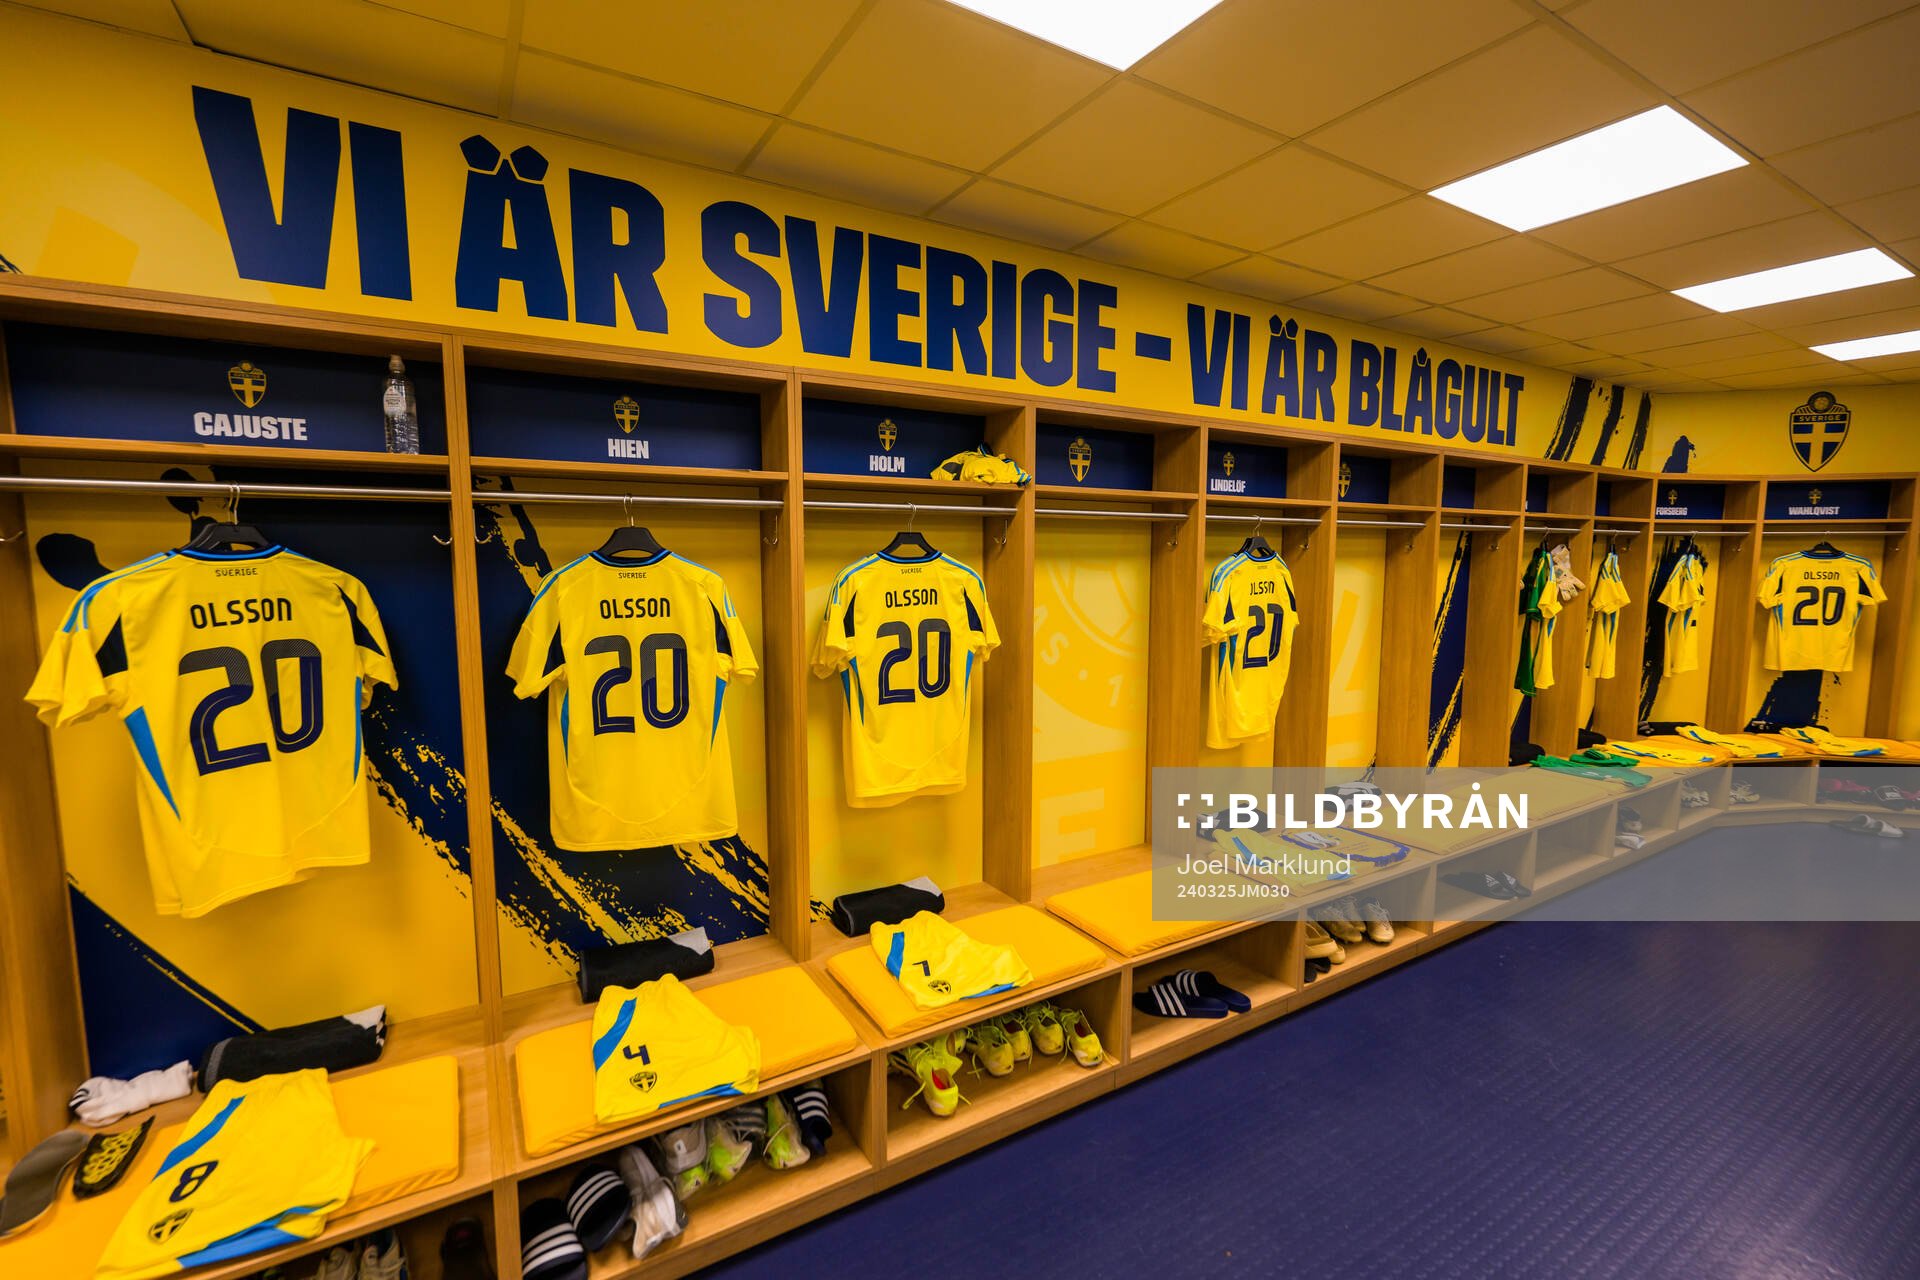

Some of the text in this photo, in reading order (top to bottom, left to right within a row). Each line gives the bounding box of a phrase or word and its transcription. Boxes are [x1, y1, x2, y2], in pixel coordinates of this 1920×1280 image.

[191, 85, 413, 302] VI
[455, 134, 669, 334] ÄR
[700, 200, 1118, 393] SVERIGE
[1187, 303, 1251, 411] VI
[1261, 314, 1338, 422] ÄR
[1348, 338, 1525, 446] BLÅGULT
[194, 411, 308, 441] CAJUSTE
[607, 438, 650, 459] HIEN
[869, 454, 905, 473] HOLM
[1210, 478, 1246, 493] LINDELÖF
[1788, 506, 1840, 516] WAHLQVIST
[215, 567, 258, 577] SVERIGE
[1803, 571, 1840, 580] OLSSON
[599, 597, 671, 619] OLSSON
[885, 588, 938, 608] OLSSON
[1792, 586, 1846, 626] 20
[189, 598, 292, 629] OLSSON
[876, 618, 951, 706] 20
[584, 633, 690, 737] 20
[178, 638, 324, 776] 20
[622, 1044, 651, 1066] 4
[168, 1160, 220, 1204] 8
